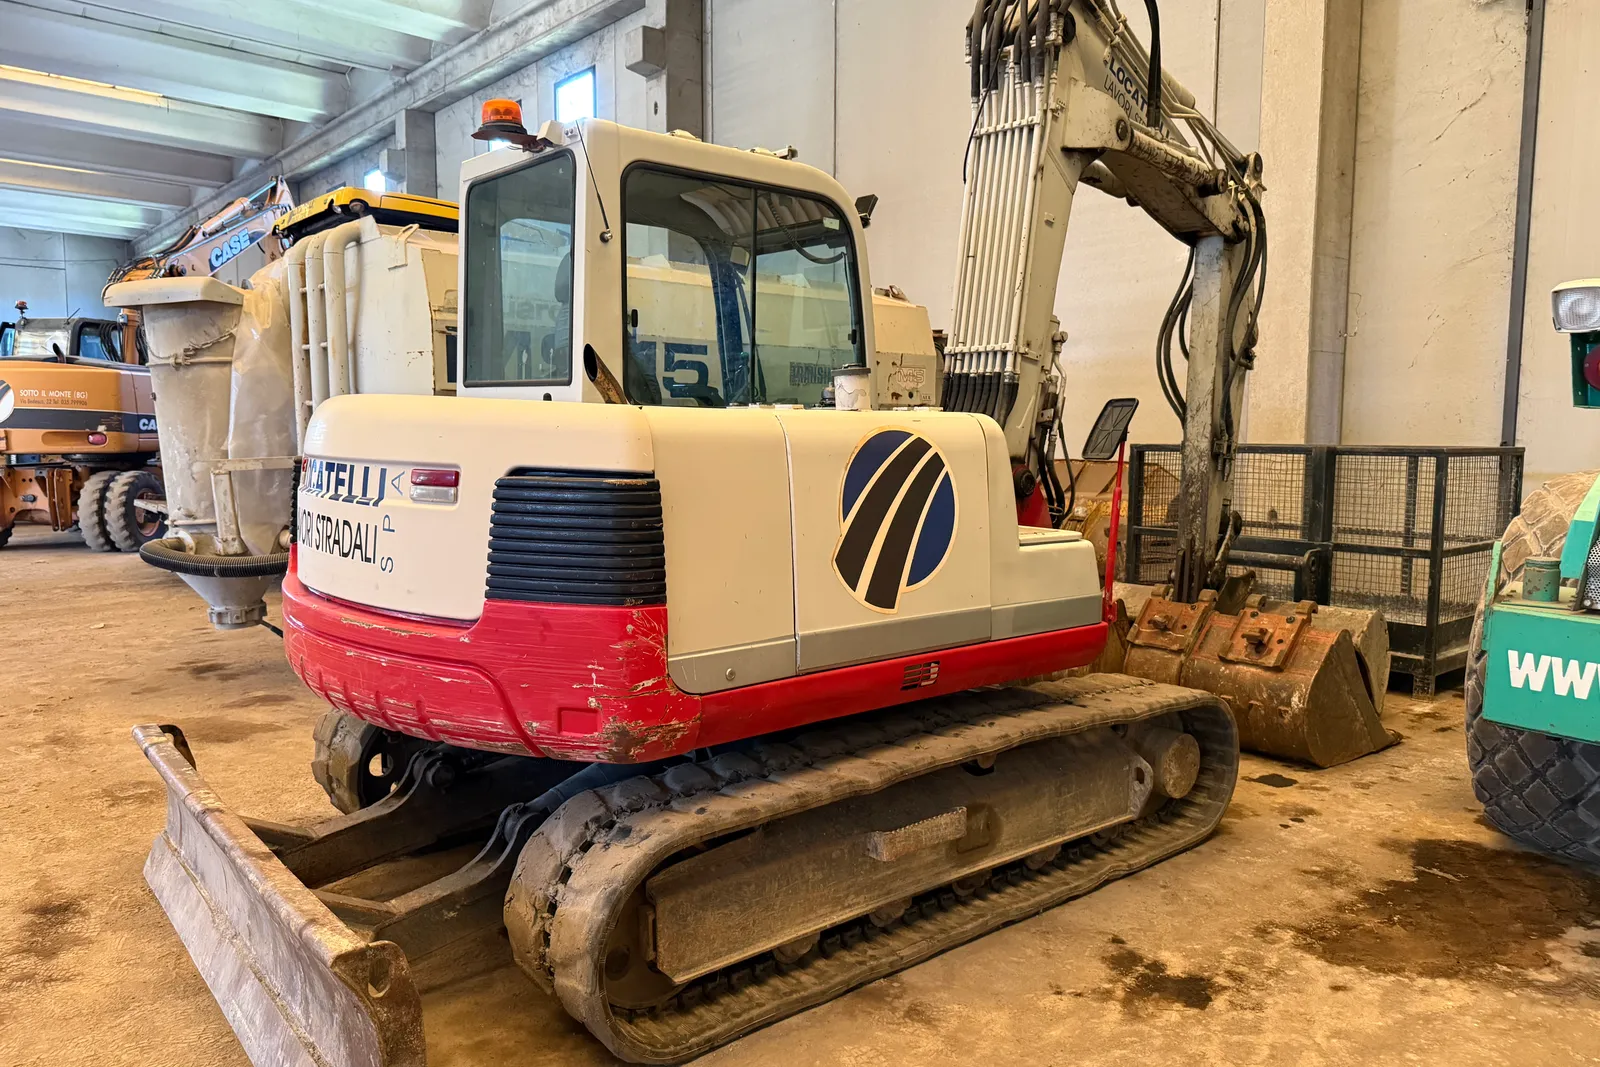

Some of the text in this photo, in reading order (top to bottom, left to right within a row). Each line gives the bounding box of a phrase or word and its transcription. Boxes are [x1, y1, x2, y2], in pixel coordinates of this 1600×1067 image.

[211, 228, 250, 267] CASE
[19, 389, 88, 400] SOTTO IL MONTE (BG)
[139, 418, 157, 430] CA
[315, 513, 377, 564] STRADALI
[380, 470, 406, 573] S P A
